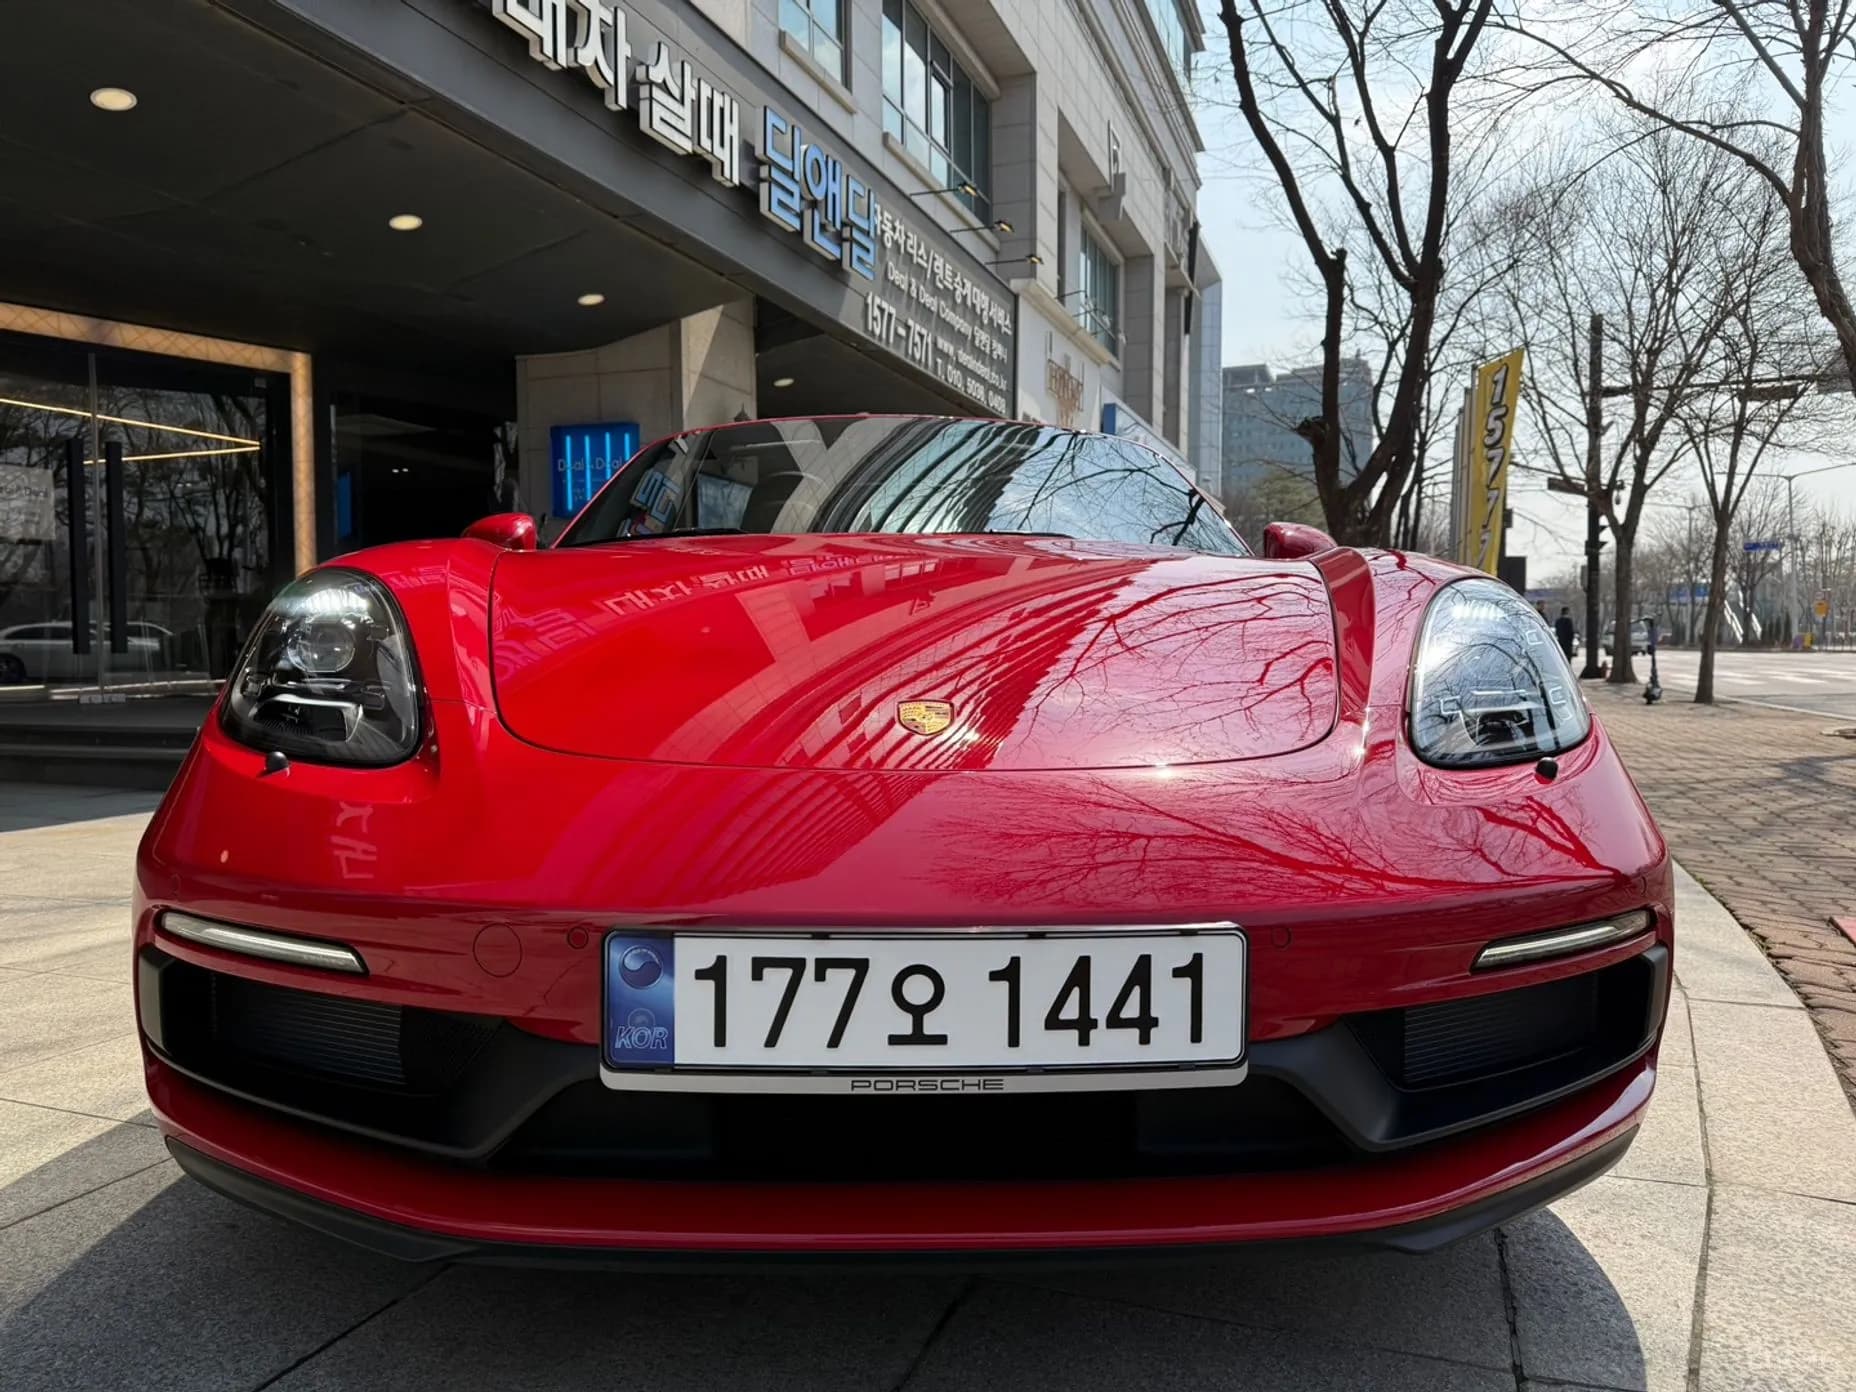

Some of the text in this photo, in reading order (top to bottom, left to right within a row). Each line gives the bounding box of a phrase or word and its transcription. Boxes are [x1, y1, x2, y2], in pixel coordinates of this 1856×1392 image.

[638, 41, 740, 187] 살때
[910, 278, 917, 299] &
[695, 952, 1204, 1049] 177오 1441
[614, 1025, 669, 1050] KOR
[851, 1078, 1004, 1092] PORSCHE
